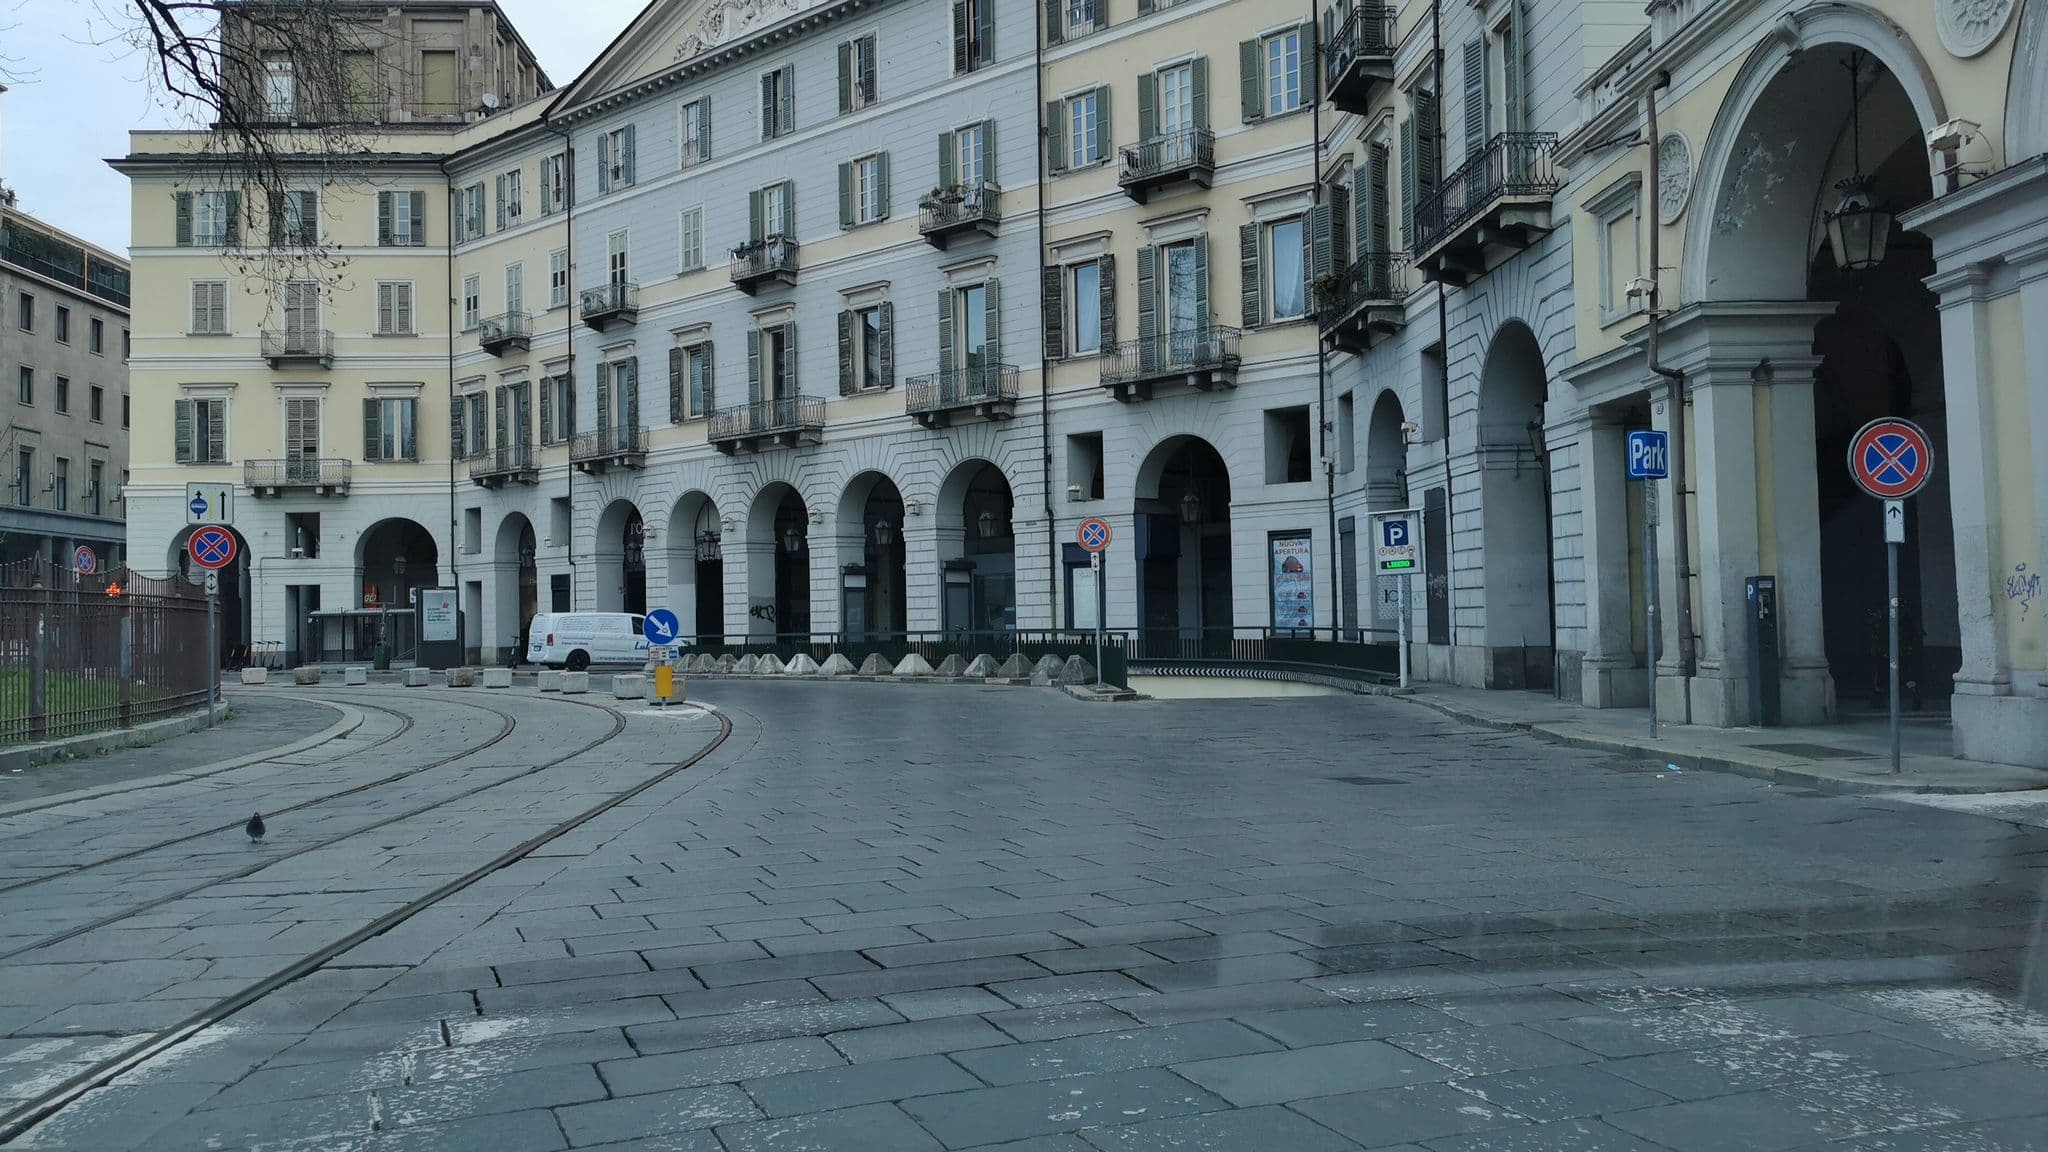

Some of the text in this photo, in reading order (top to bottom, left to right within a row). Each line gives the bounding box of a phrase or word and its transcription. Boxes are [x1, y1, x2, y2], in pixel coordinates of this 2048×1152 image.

[1632, 438, 1664, 470] Park
[1390, 528, 1403, 545] P
[1747, 584, 1754, 600] P
